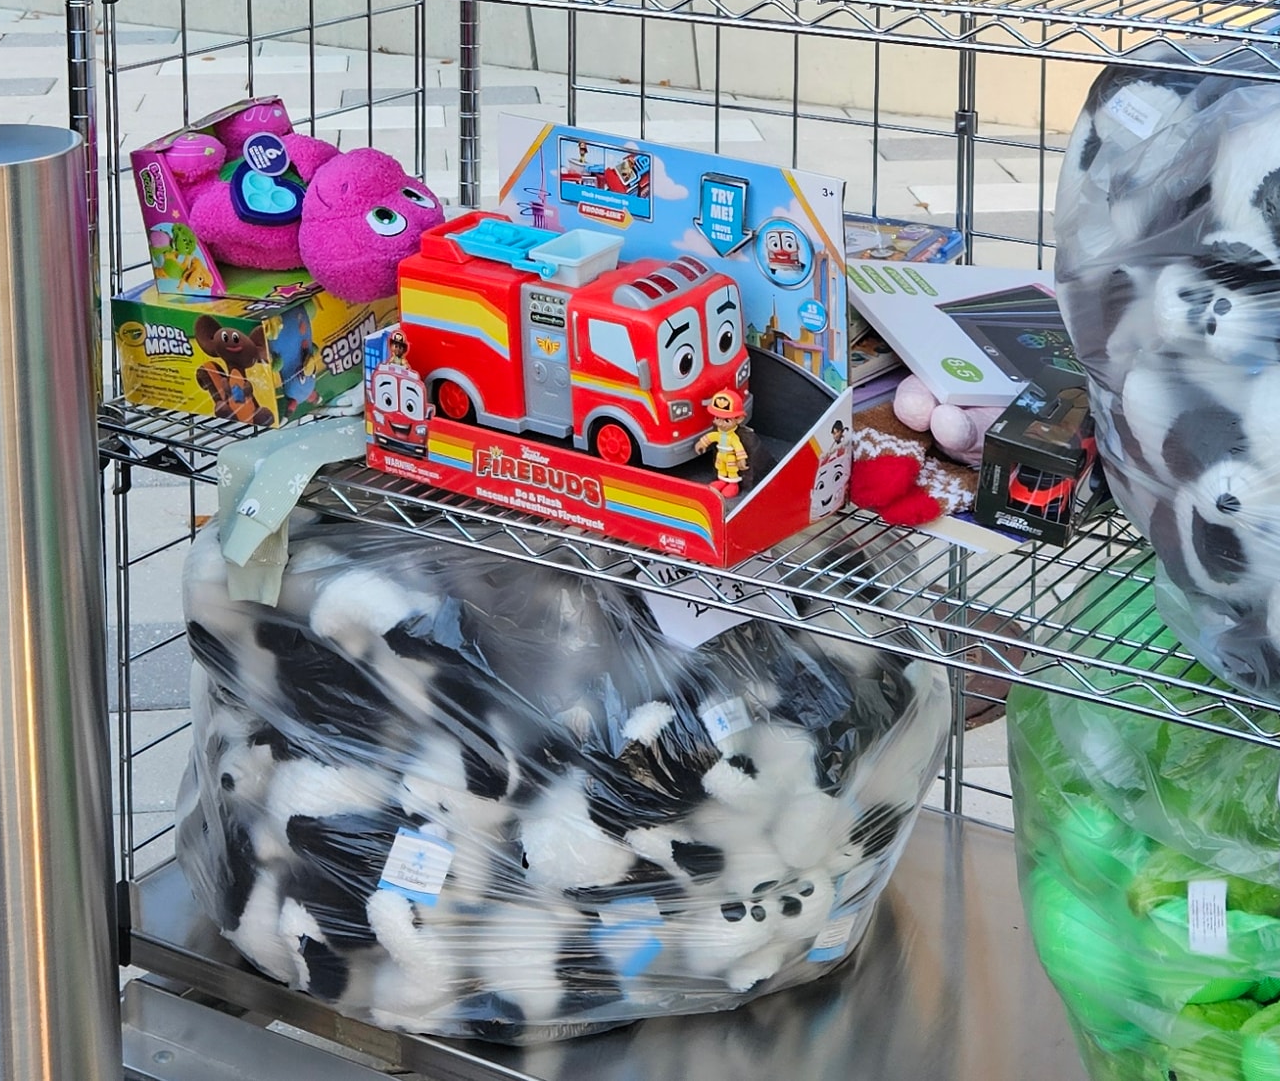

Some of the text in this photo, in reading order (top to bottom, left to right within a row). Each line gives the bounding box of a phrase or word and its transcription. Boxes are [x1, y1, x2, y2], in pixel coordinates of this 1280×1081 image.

[711, 187, 734, 206] TRY
[822, 188, 834, 198] 3+
[710, 203, 733, 223] ME!
[145, 323, 187, 341] MODEL
[328, 349, 362, 375] ODEL
[476, 487, 605, 530] Rescue Adventure Firetruck
[528, 492, 536, 501] &
[537, 493, 562, 509] Flash
[996, 518, 1043, 536] FURIOUS
